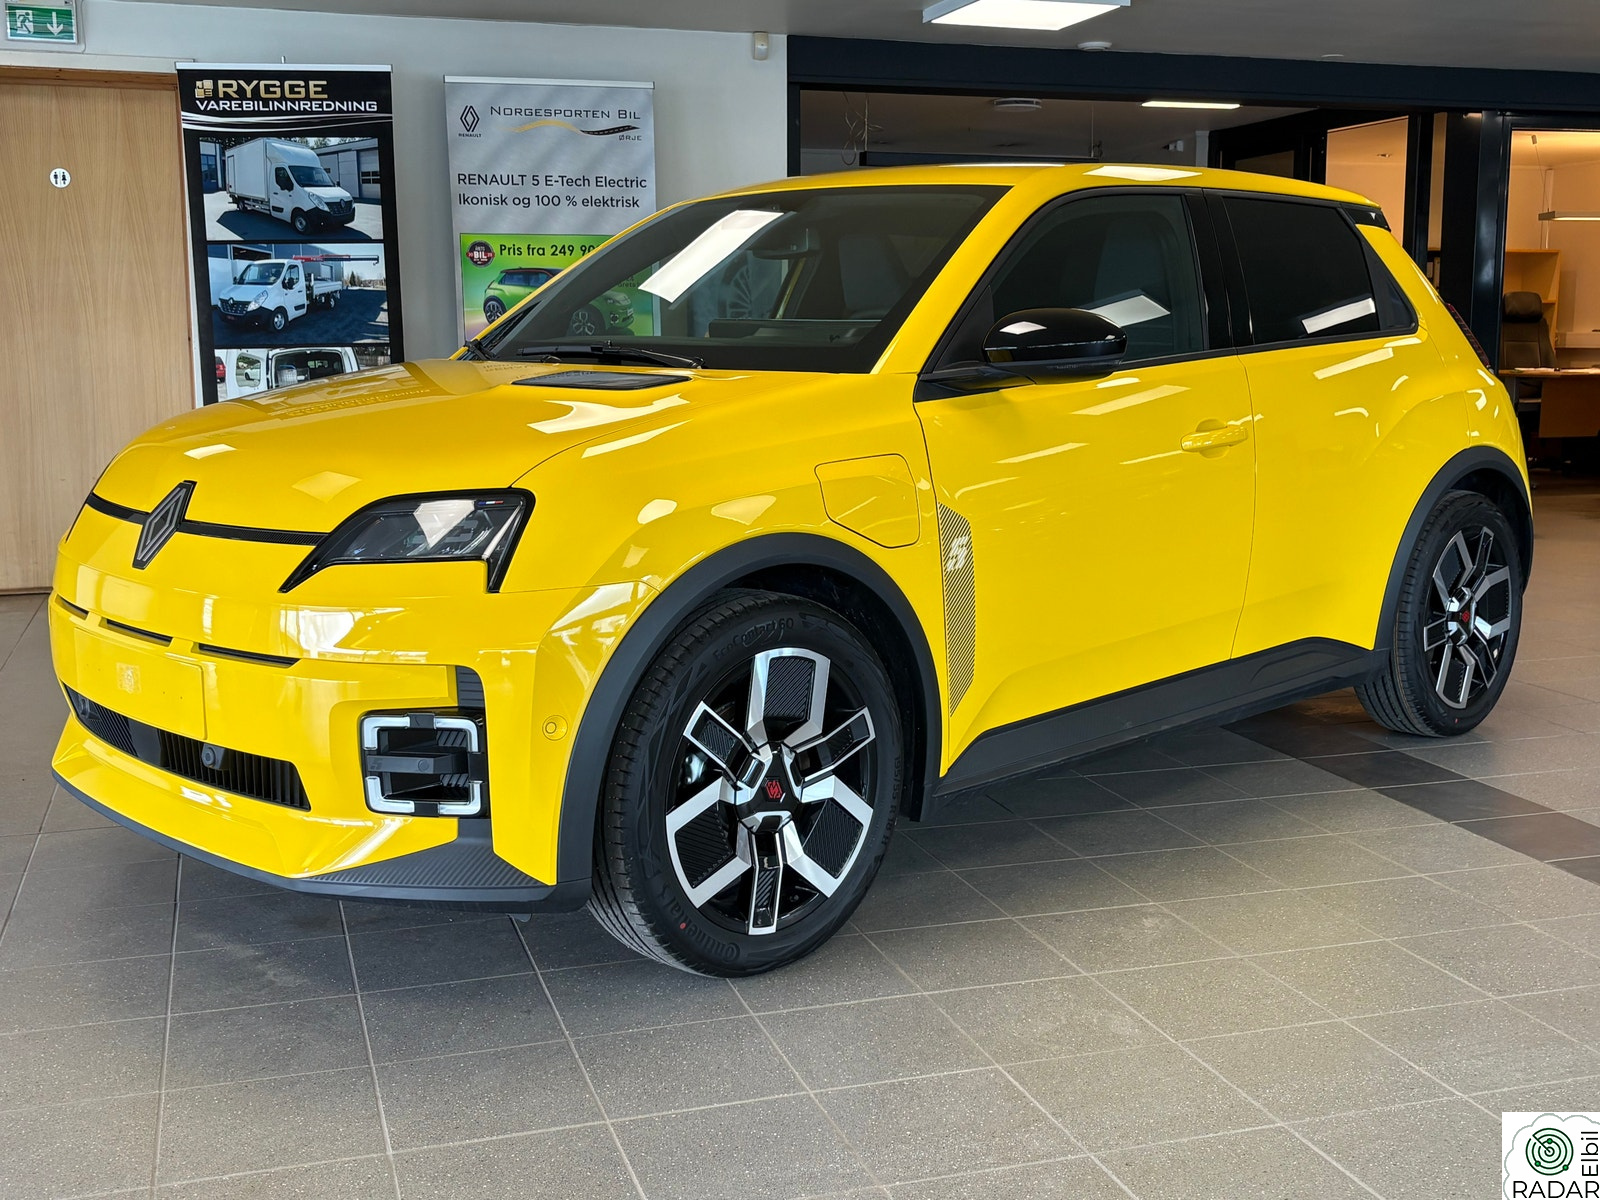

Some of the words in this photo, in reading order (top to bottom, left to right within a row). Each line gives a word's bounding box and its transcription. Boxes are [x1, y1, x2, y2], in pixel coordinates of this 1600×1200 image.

[218, 79, 328, 99] RYGGE
[195, 100, 378, 112] VAREBILINNREDNING
[457, 173, 527, 186] RENAULT
[532, 175, 540, 187] 5
[544, 175, 590, 187] E-Tech
[595, 176, 647, 189] Electric
[458, 193, 508, 206] Ikonisk
[512, 197, 531, 209] og
[535, 195, 561, 207] 100
[565, 196, 578, 207] %
[581, 195, 640, 208] elektrisk
[473, 251, 487, 259] BIL
[500, 244, 523, 256] Pris
[527, 244, 546, 256] fra
[550, 244, 575, 257] 249
